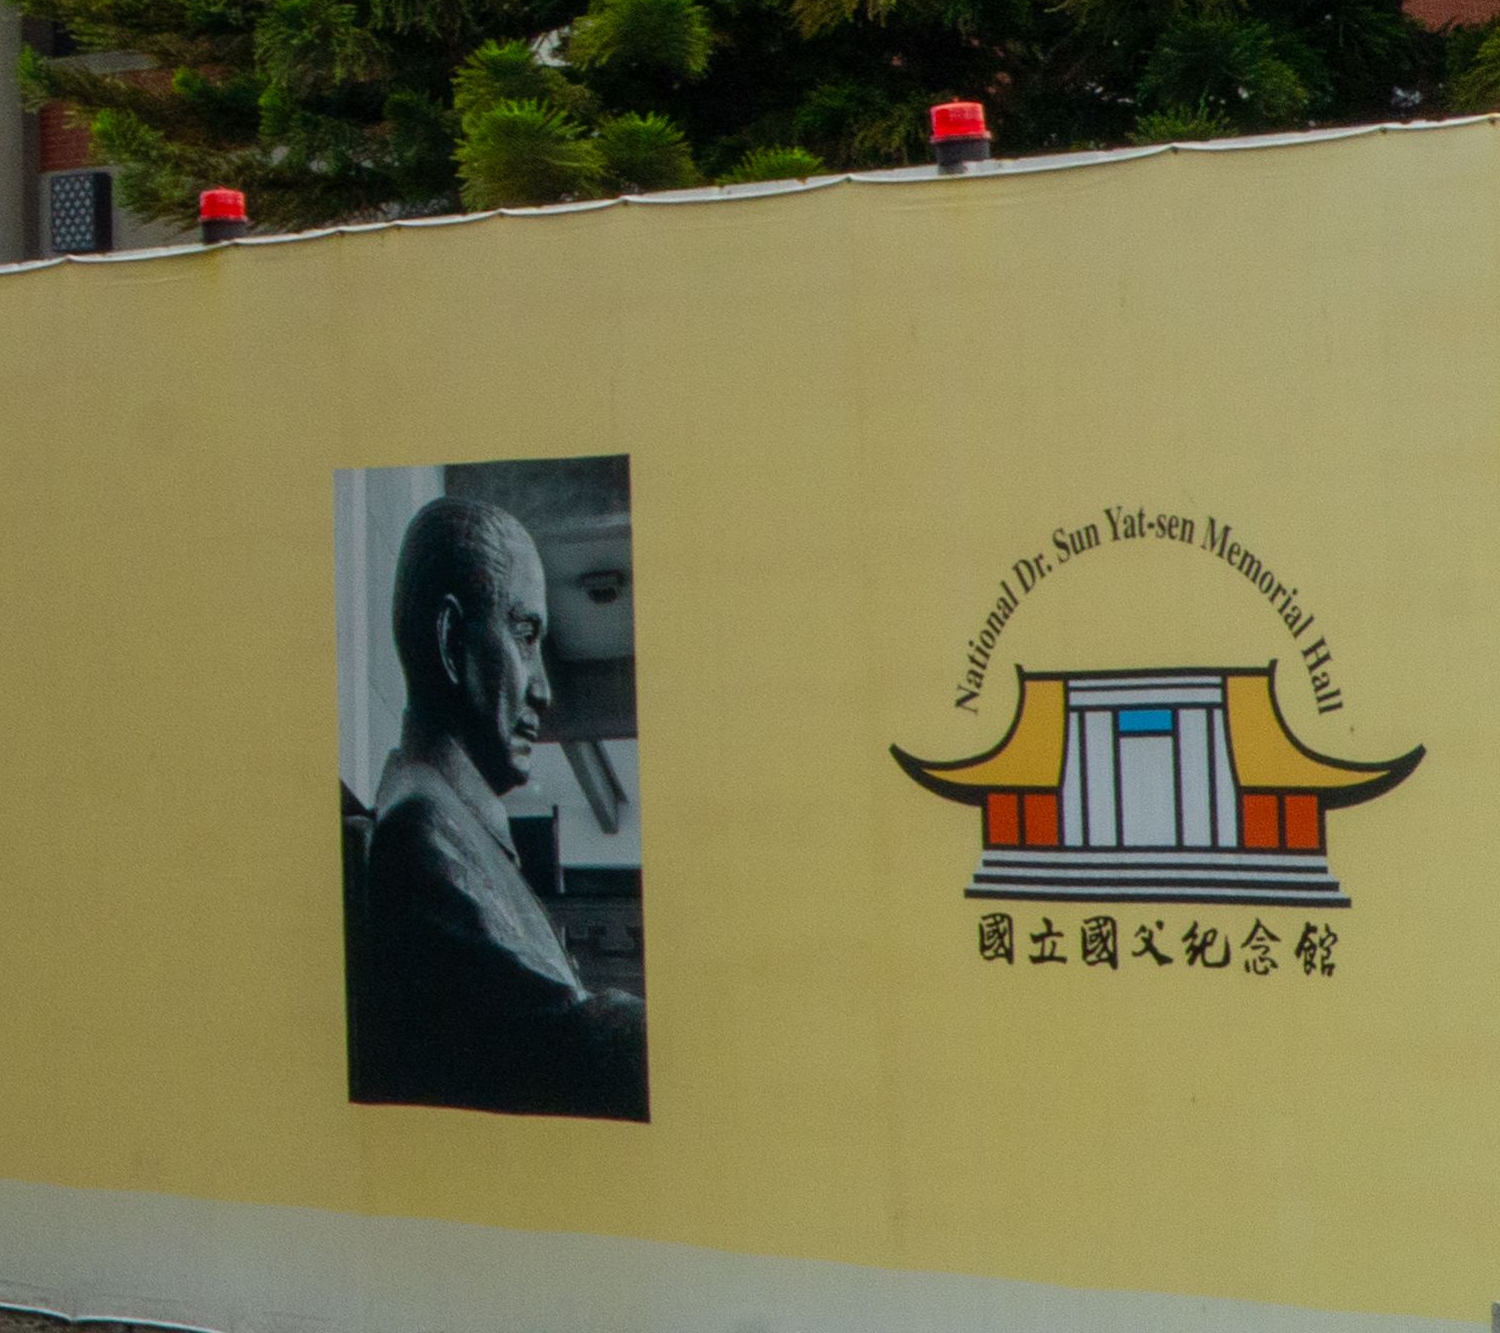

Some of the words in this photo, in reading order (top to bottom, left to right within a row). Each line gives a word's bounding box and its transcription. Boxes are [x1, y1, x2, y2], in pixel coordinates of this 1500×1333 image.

[955, 579, 1020, 715] National
[1012, 552, 1054, 595] Dr.
[1052, 527, 1102, 565] Sun
[1103, 505, 1196, 545] Yat-sen
[1200, 515, 1315, 639] Memorial
[1301, 635, 1344, 716] Hall
[978, 912, 1339, 978] 國立國父紀念館
